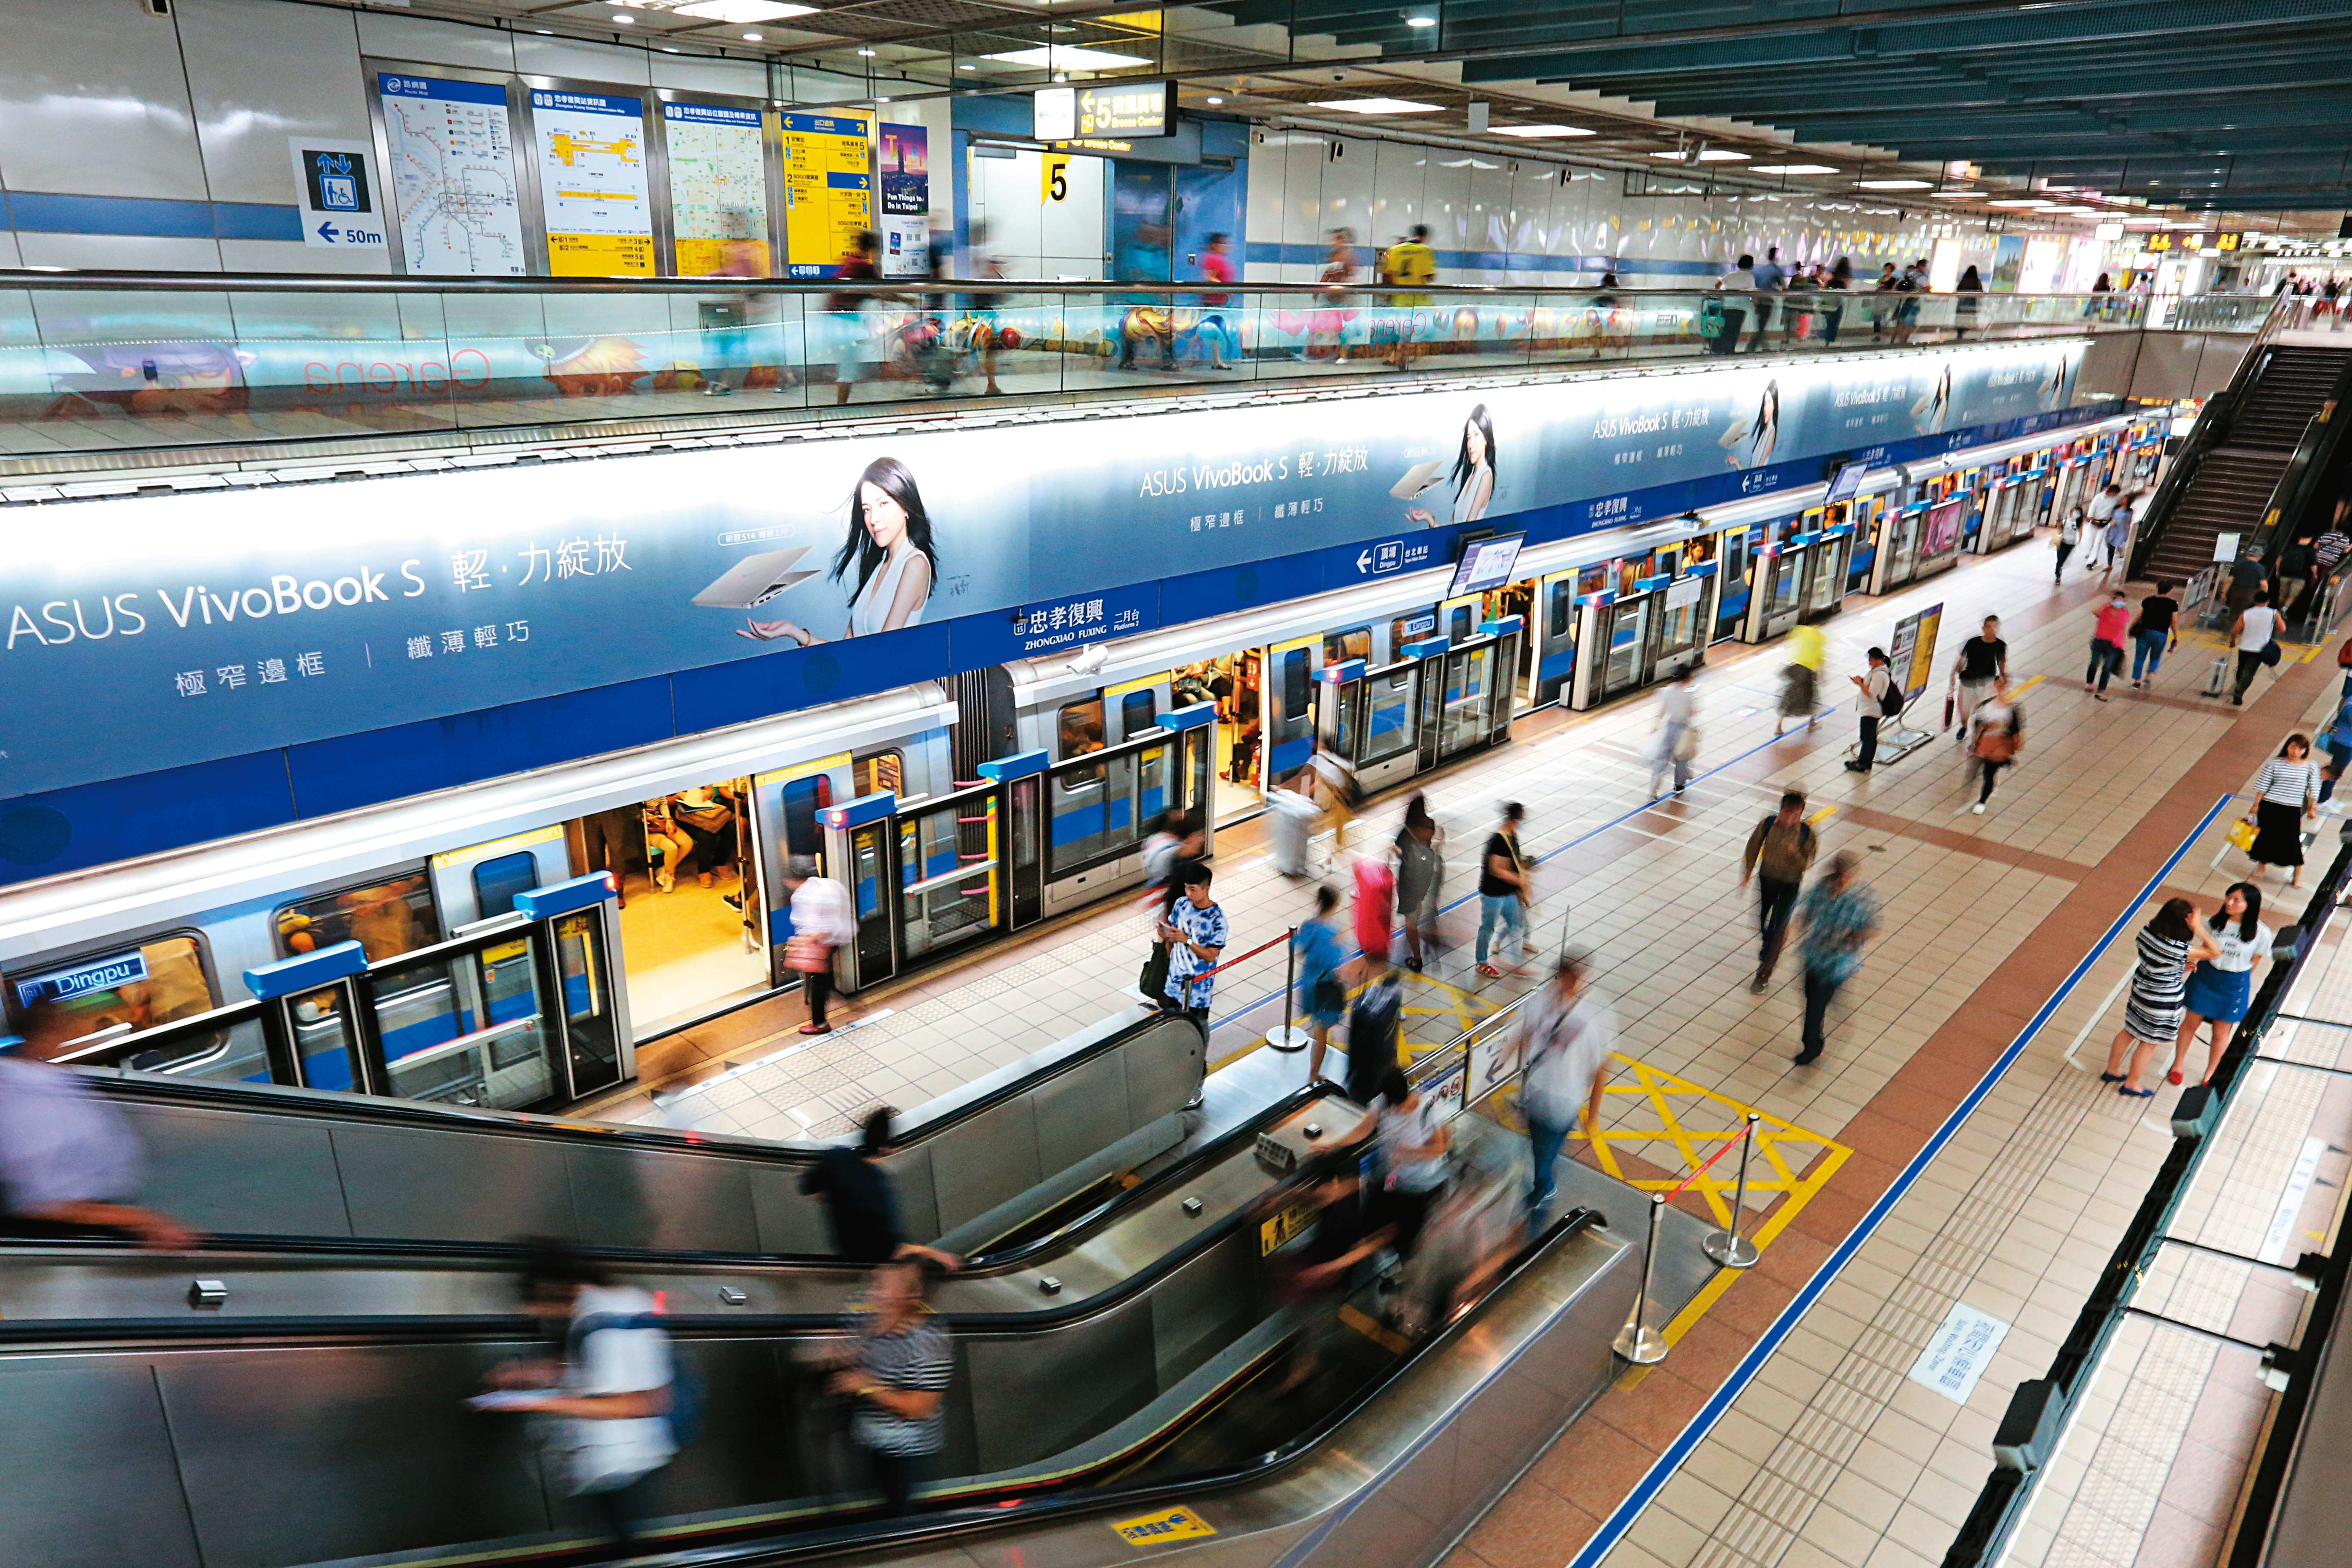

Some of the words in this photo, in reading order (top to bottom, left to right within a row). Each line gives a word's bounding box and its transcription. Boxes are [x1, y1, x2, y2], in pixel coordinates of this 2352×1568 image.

[1096, 97, 1111, 129] 5
[1111, 117, 1137, 128] Breeze
[1137, 116, 1163, 127] Center
[786, 136, 789, 145] 1
[860, 142, 864, 150] 5
[1108, 139, 1131, 151] Center
[787, 174, 793, 183] 2
[1050, 164, 1067, 201] 5
[862, 192, 866, 201] 3
[902, 203, 918, 211] Taipei
[347, 229, 381, 244] 50m
[1592, 418, 1617, 439] ASUS
[1619, 414, 1661, 436] VivoBook
[1661, 412, 1668, 430] S
[1140, 468, 1187, 498] ASUS
[1192, 459, 1273, 491] VivoBook
[1278, 455, 1288, 481] S
[1190, 510, 1245, 532] 極窄邊框
[7, 593, 146, 650] ASUS
[157, 566, 389, 628] VivoBook
[400, 559, 425, 597] S
[1029, 598, 1104, 634] 忠孝復興
[1114, 609, 1140, 624] 二月台
[1114, 622, 1135, 631] Platform
[407, 620, 530, 660] 纖薄輕巧
[1025, 632, 1075, 650] ZHONGXIAO
[1078, 625, 1107, 639] FUXING
[175, 651, 325, 698] 極窄邊框
[55, 963, 131, 994] Dingpu
[797, 1032, 834, 1049] Waiting
[1936, 1333, 1959, 1356] Waiting
